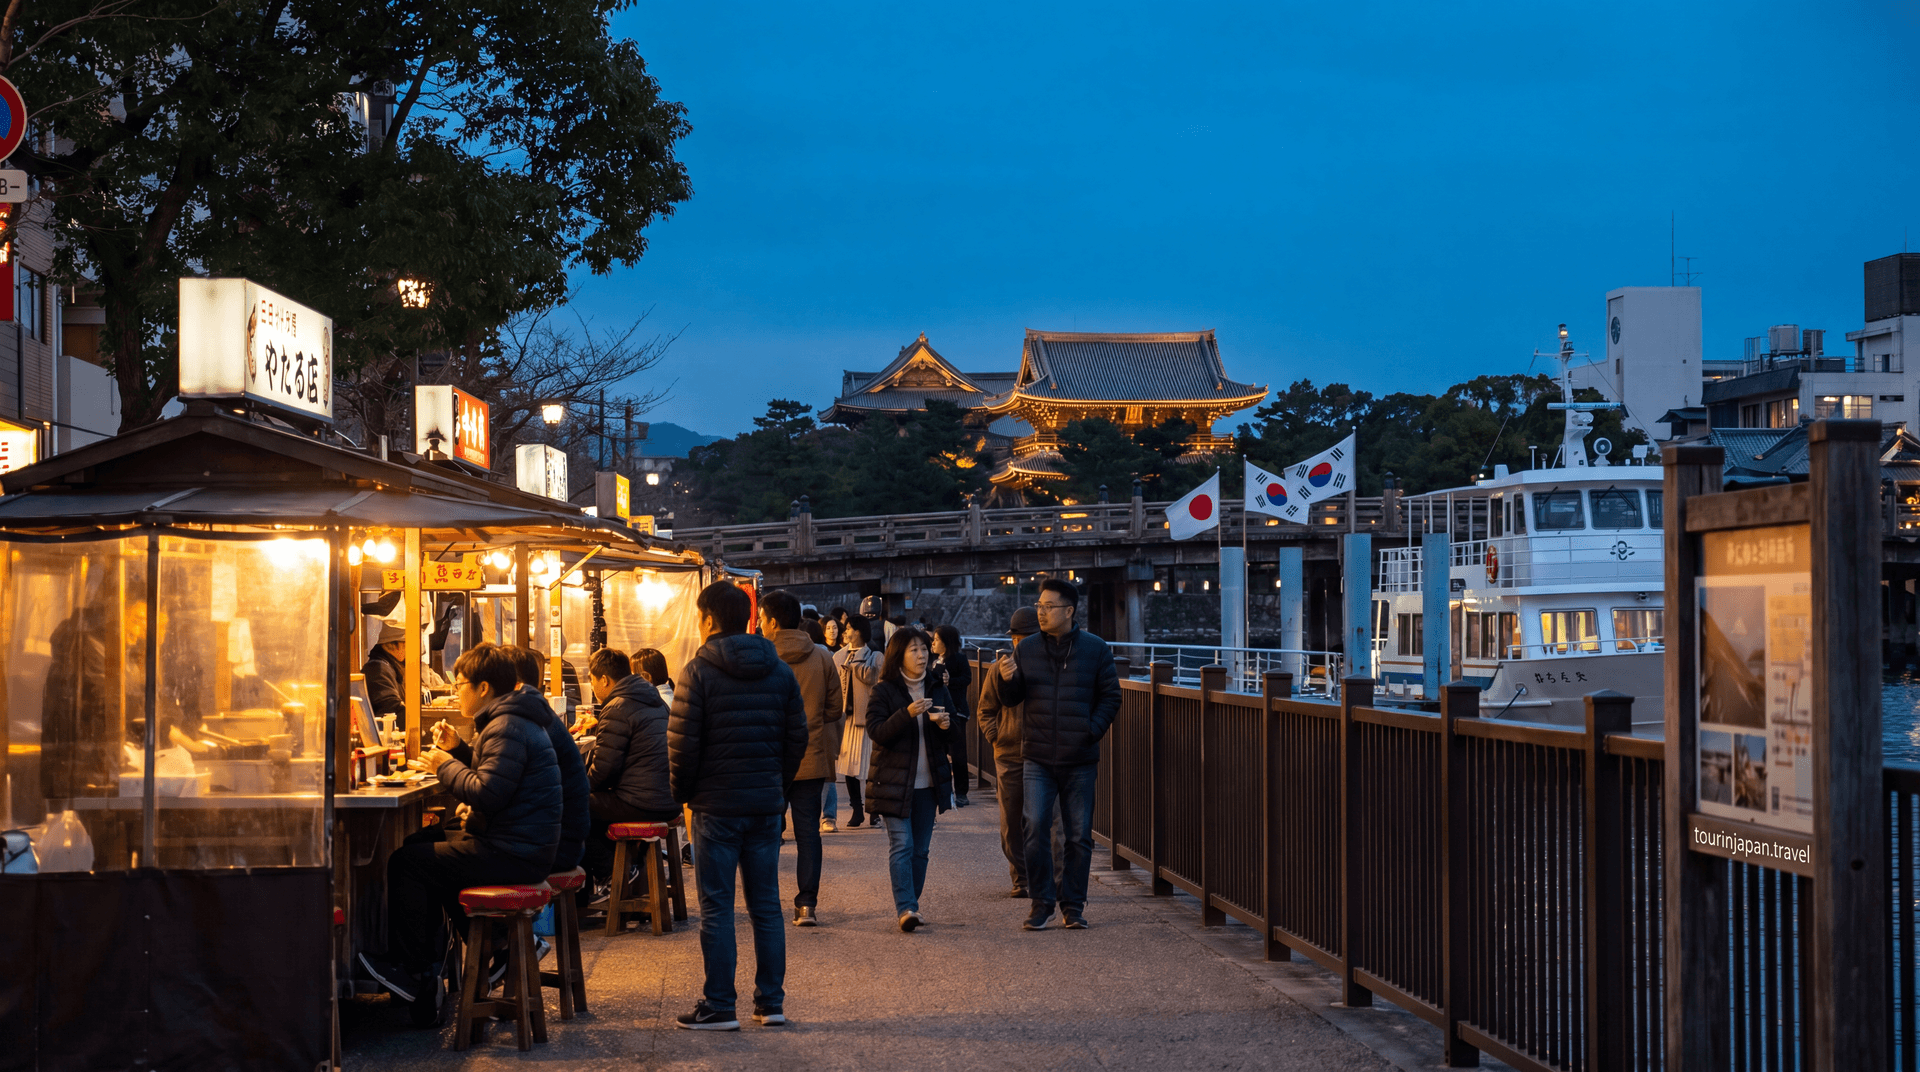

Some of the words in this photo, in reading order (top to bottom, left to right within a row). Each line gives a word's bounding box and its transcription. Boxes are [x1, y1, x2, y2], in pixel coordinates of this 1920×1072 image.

[265, 340, 318, 404] やたる店
[1694, 827, 1810, 863] tourinjapan.travel
